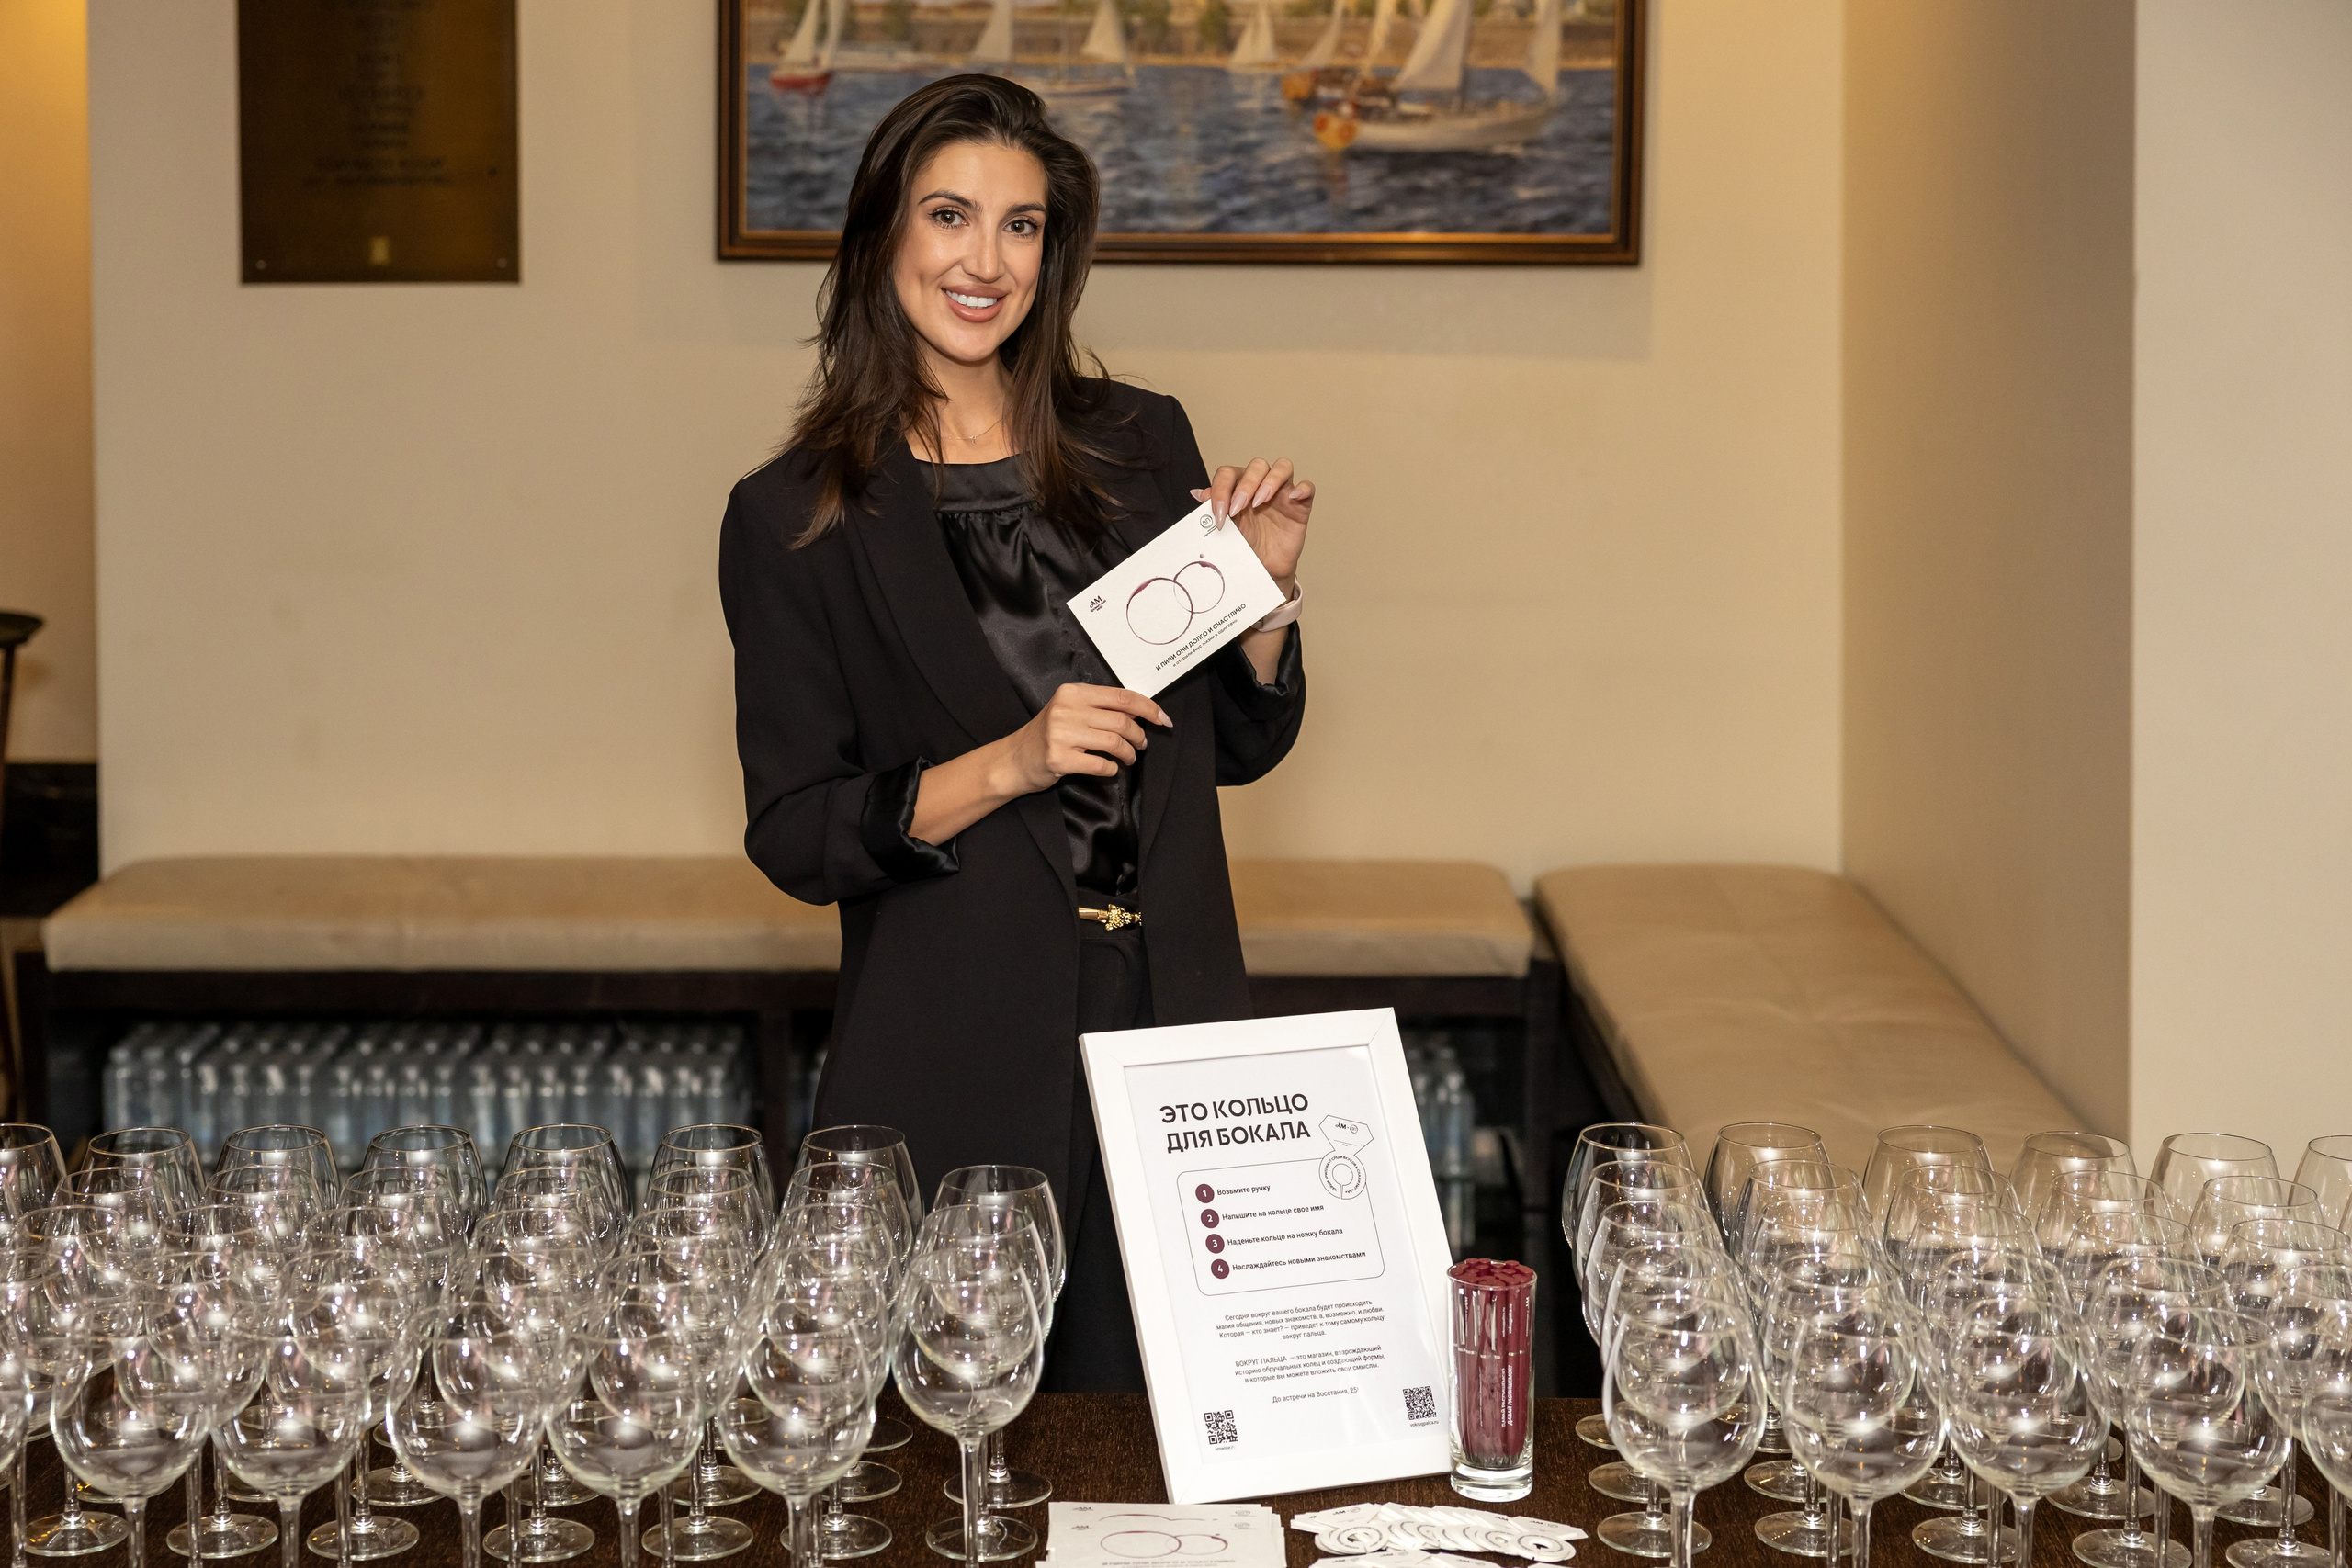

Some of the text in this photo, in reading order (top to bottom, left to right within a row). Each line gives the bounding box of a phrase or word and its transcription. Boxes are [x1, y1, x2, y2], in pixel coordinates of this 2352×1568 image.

[1160, 654, 1177, 668] ПИЛИ
[1176, 645, 1189, 656] ОНИ
[1188, 631, 1208, 648] ДОЛГО
[1212, 603, 1246, 630] СЧАСТЛИВО
[1159, 1093, 1309, 1124] ЭТО КОЛЬЦО
[1166, 1120, 1311, 1154] ДЛЯ БОКАЛА
[1217, 1187, 1250, 1196] Возьмите
[1251, 1185, 1270, 1194] ручку
[1221, 1212, 1257, 1221] Напишите
[1227, 1237, 1260, 1246] Наденьте
[1232, 1260, 1287, 1271] Наслаждайтесь
[1316, 1251, 1366, 1262] знакомствами
[1316, 1304, 1334, 1312] будет
[1334, 1300, 1373, 1310] происходить
[1235, 1320, 1264, 1329] общения,
[1284, 1314, 1319, 1323] знакомств,
[1324, 1310, 1358, 1319] возможно,
[1263, 1325, 1283, 1334] знает?
[1290, 1322, 1318, 1331] приведет
[1235, 1358, 1259, 1367] ВОКРУГ
[1260, 1355, 1288, 1364] ПАЛЬЦА
[1262, 1363, 1302, 1373] обручальных
[1362, 1354, 1386, 1362] формы,
[1352, 1363, 1380, 1371] смыслы.
[1315, 1389, 1350, 1398] Восстания,
